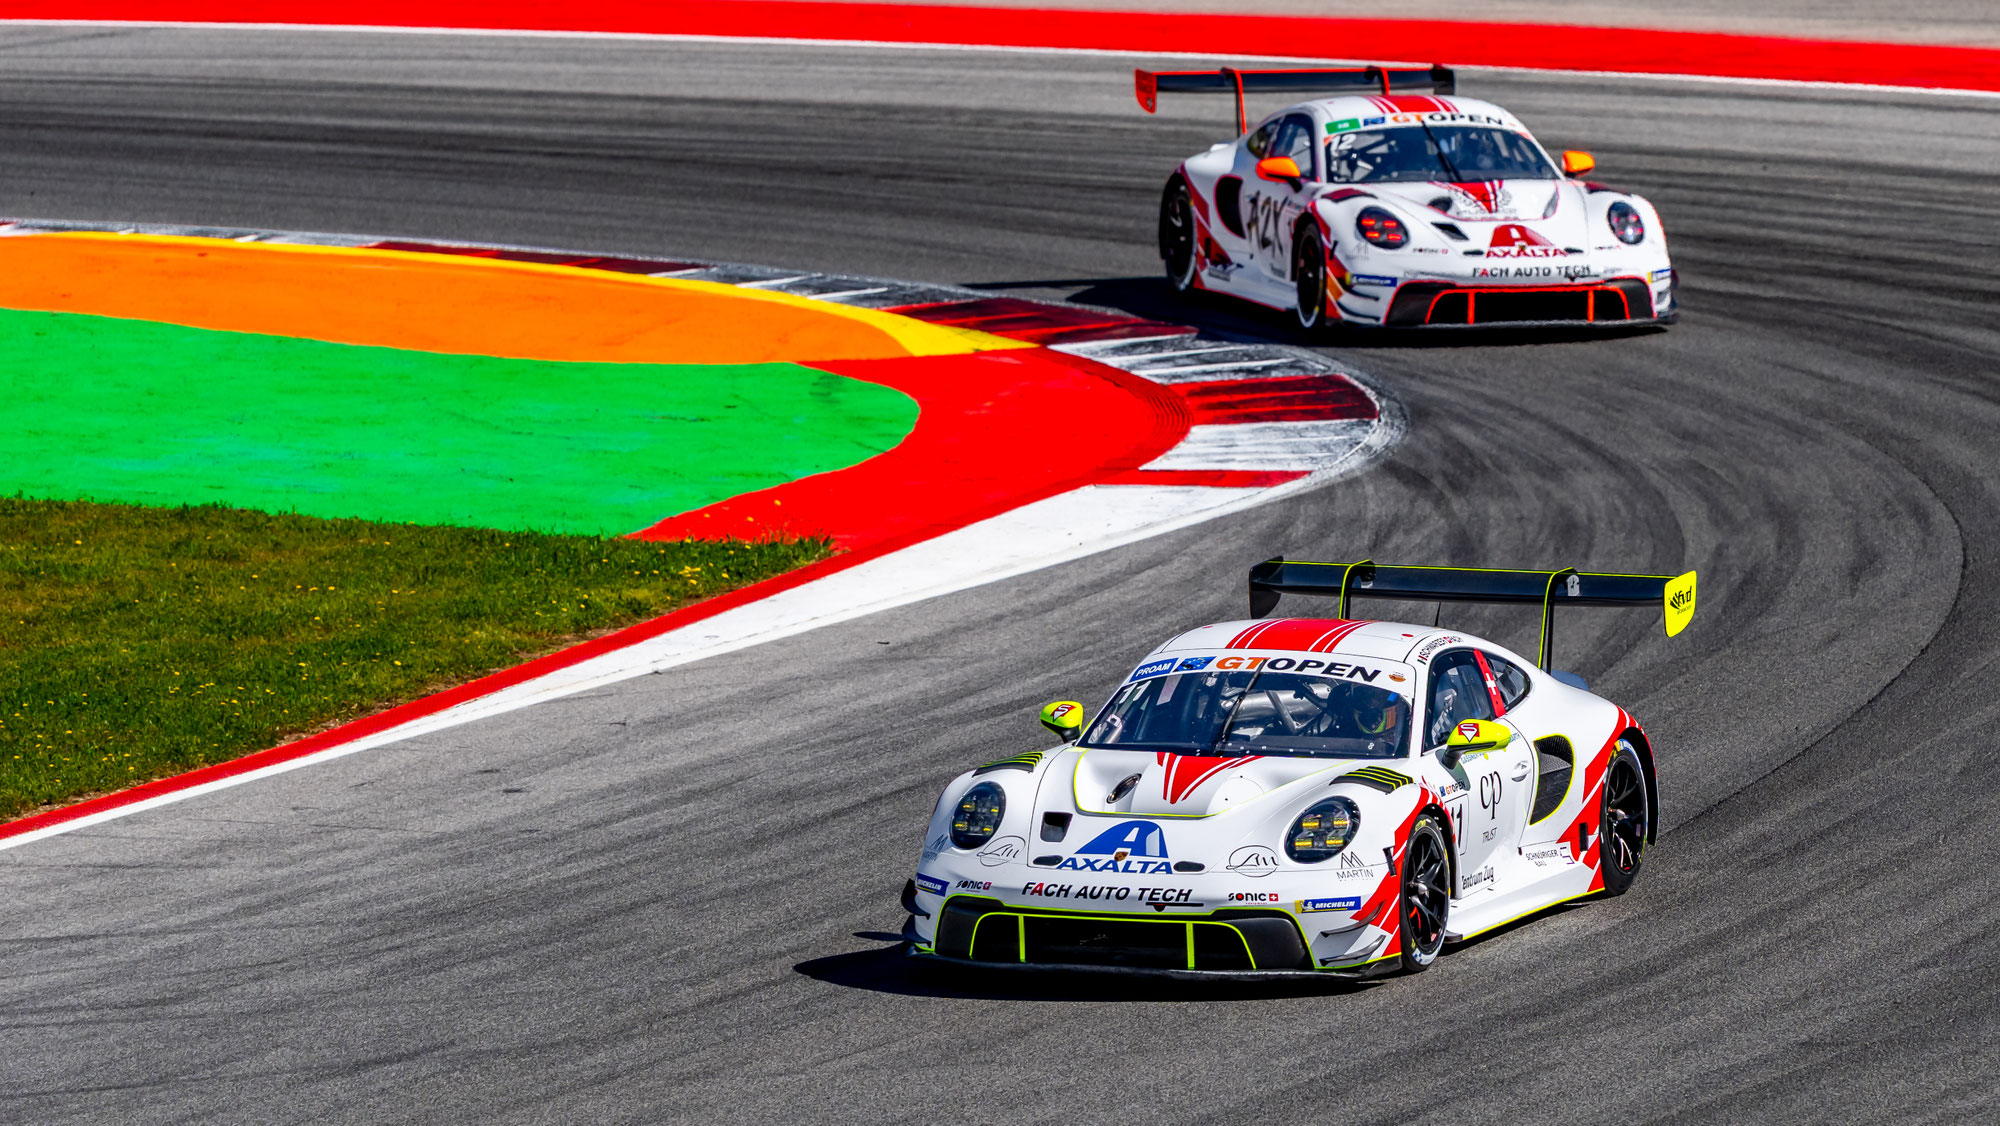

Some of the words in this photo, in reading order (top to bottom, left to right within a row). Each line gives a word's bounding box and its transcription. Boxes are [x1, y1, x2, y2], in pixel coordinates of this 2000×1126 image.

[1330, 133, 1356, 151] 12
[1486, 248, 1569, 258] AXALTA
[1472, 267, 1509, 277] FACH
[1513, 267, 1550, 277] AUTO
[1556, 265, 1591, 278] TECH
[1135, 662, 1172, 677] PROAM
[1118, 680, 1152, 704] 11
[1482, 826, 1498, 844] TRUST
[1056, 857, 1174, 875] AXALTA
[1336, 869, 1375, 880] MARTIN
[1483, 864, 1495, 883] Zug
[1022, 881, 1073, 898] FACH
[1074, 885, 1131, 901] AUTO
[1137, 887, 1193, 902] TECH
[1315, 901, 1356, 909] MICHELIN
